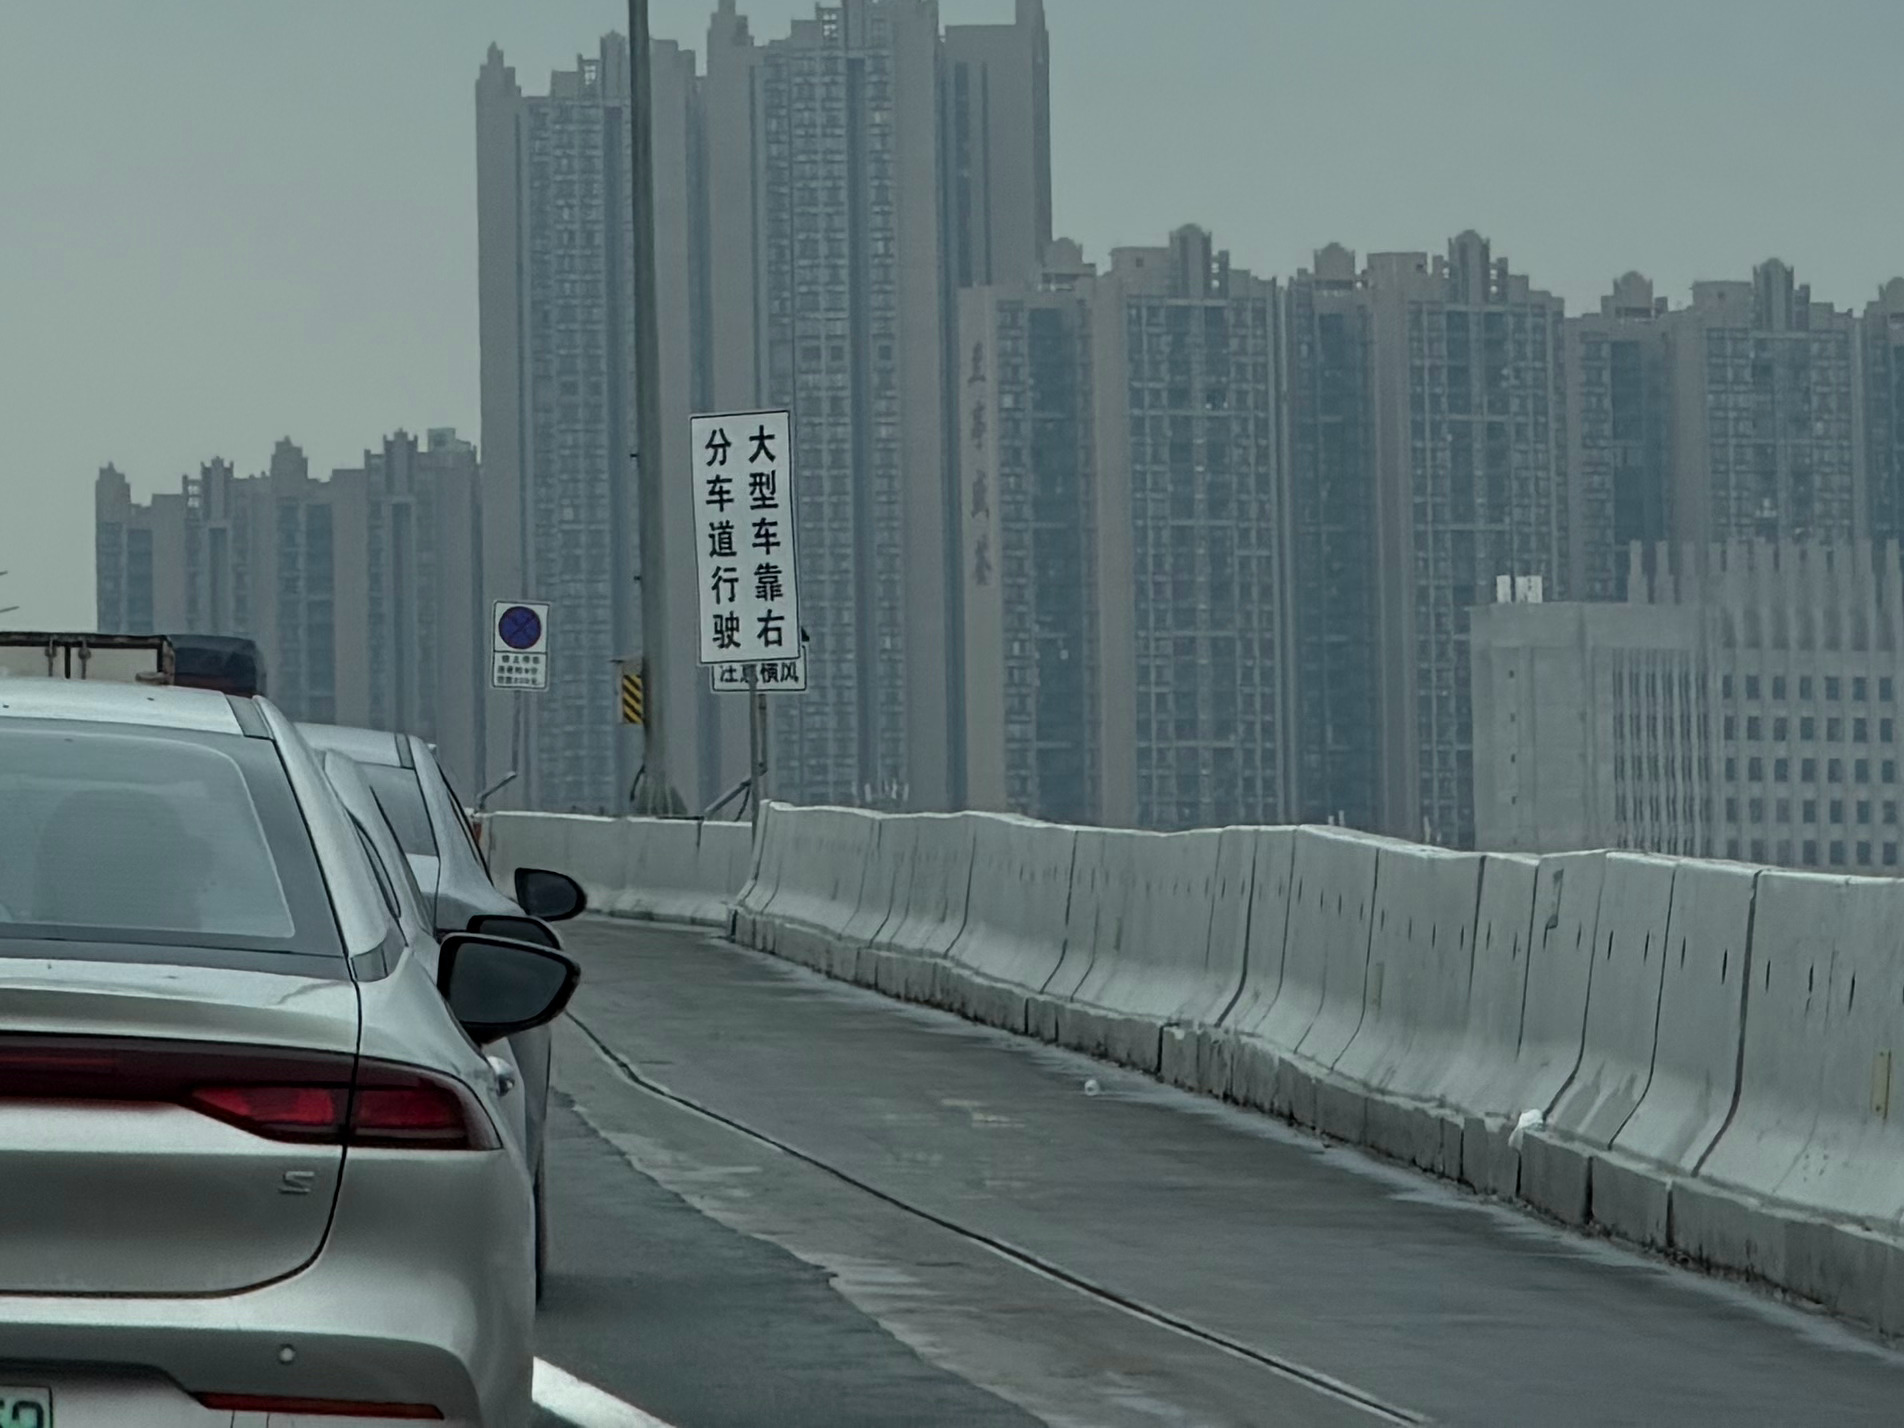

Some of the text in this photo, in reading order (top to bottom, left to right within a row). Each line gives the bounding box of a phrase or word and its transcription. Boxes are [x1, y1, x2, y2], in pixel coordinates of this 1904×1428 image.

[704, 427, 742, 649] 分车道行驶
[747, 424, 785, 648] 大型车靠右
